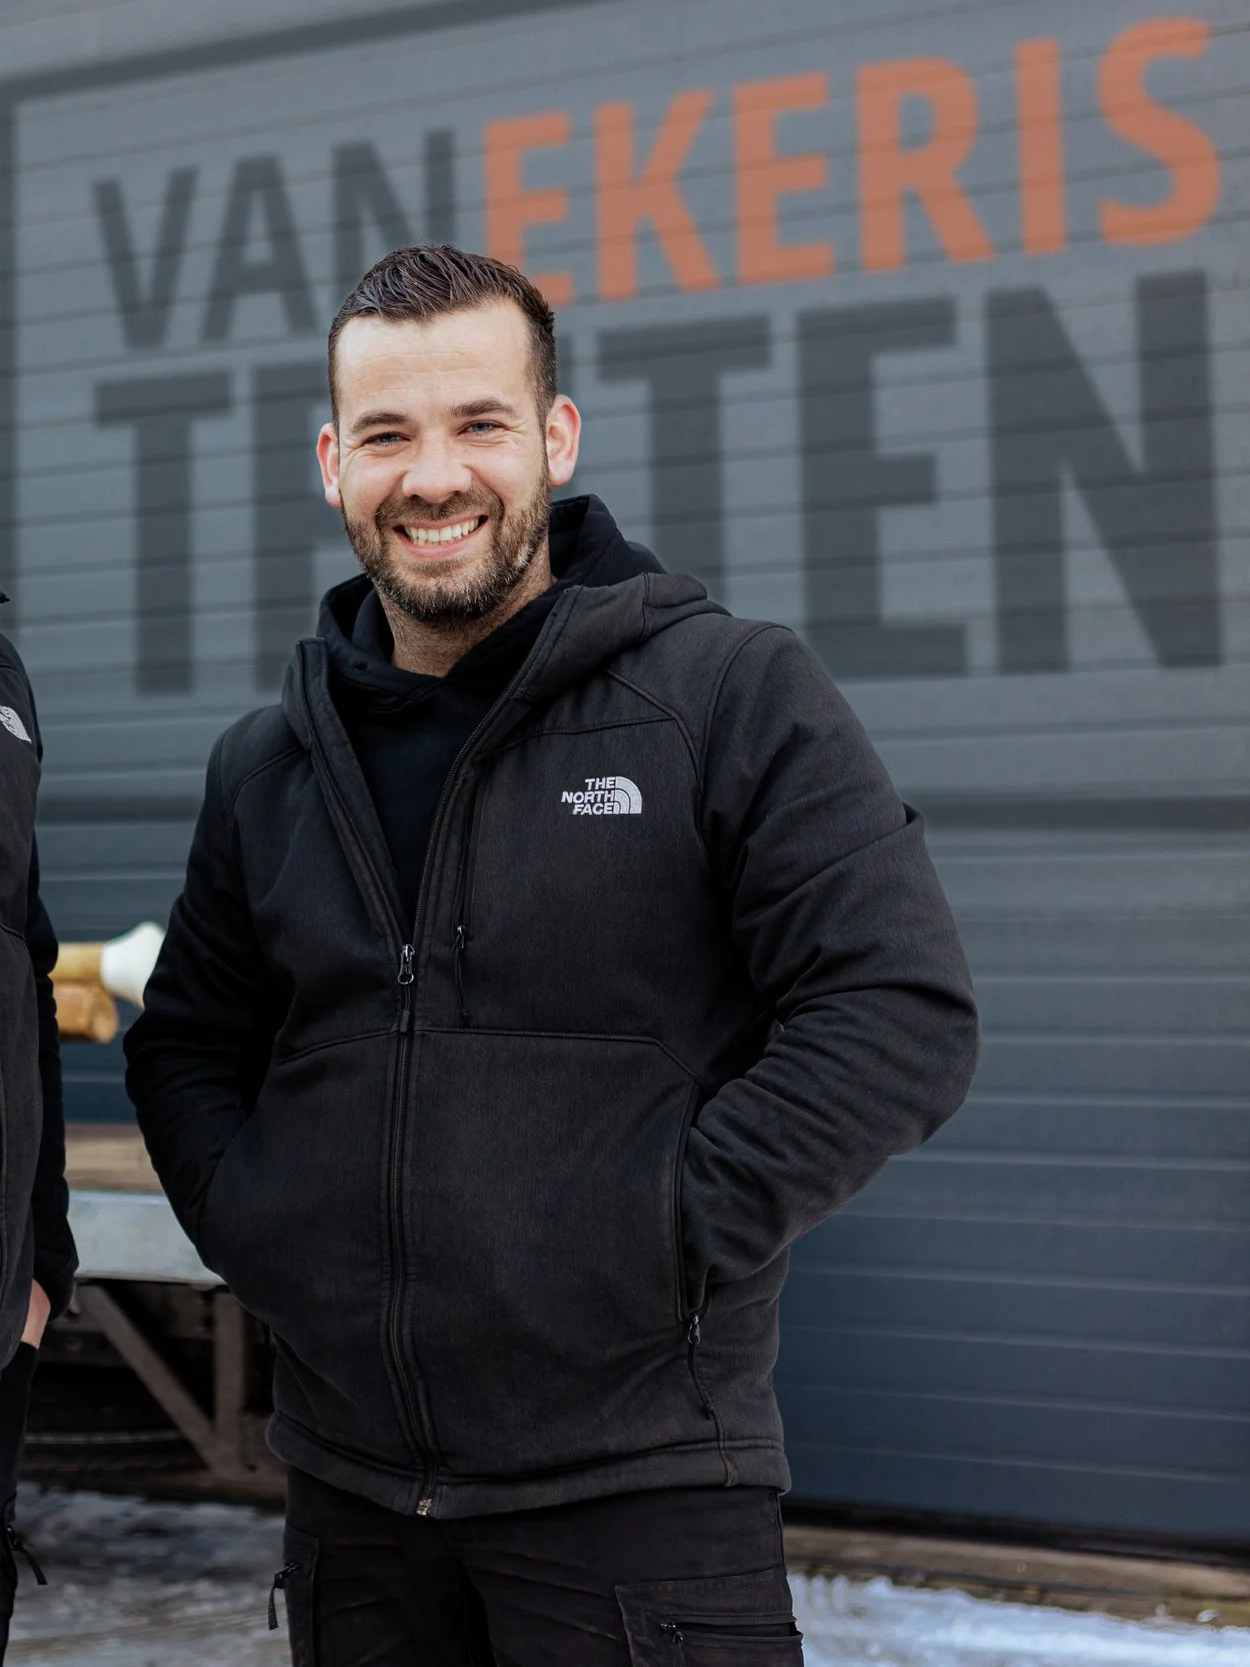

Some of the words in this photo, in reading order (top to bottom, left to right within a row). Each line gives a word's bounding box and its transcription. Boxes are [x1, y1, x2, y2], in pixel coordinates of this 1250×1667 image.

[92, 128, 455, 351] VAN
[484, 16, 1222, 307] EKERIS
[94, 269, 1223, 697] TETEN
[585, 777, 615, 790] THE
[561, 790, 614, 803] NORTH
[572, 802, 614, 815] FACE
